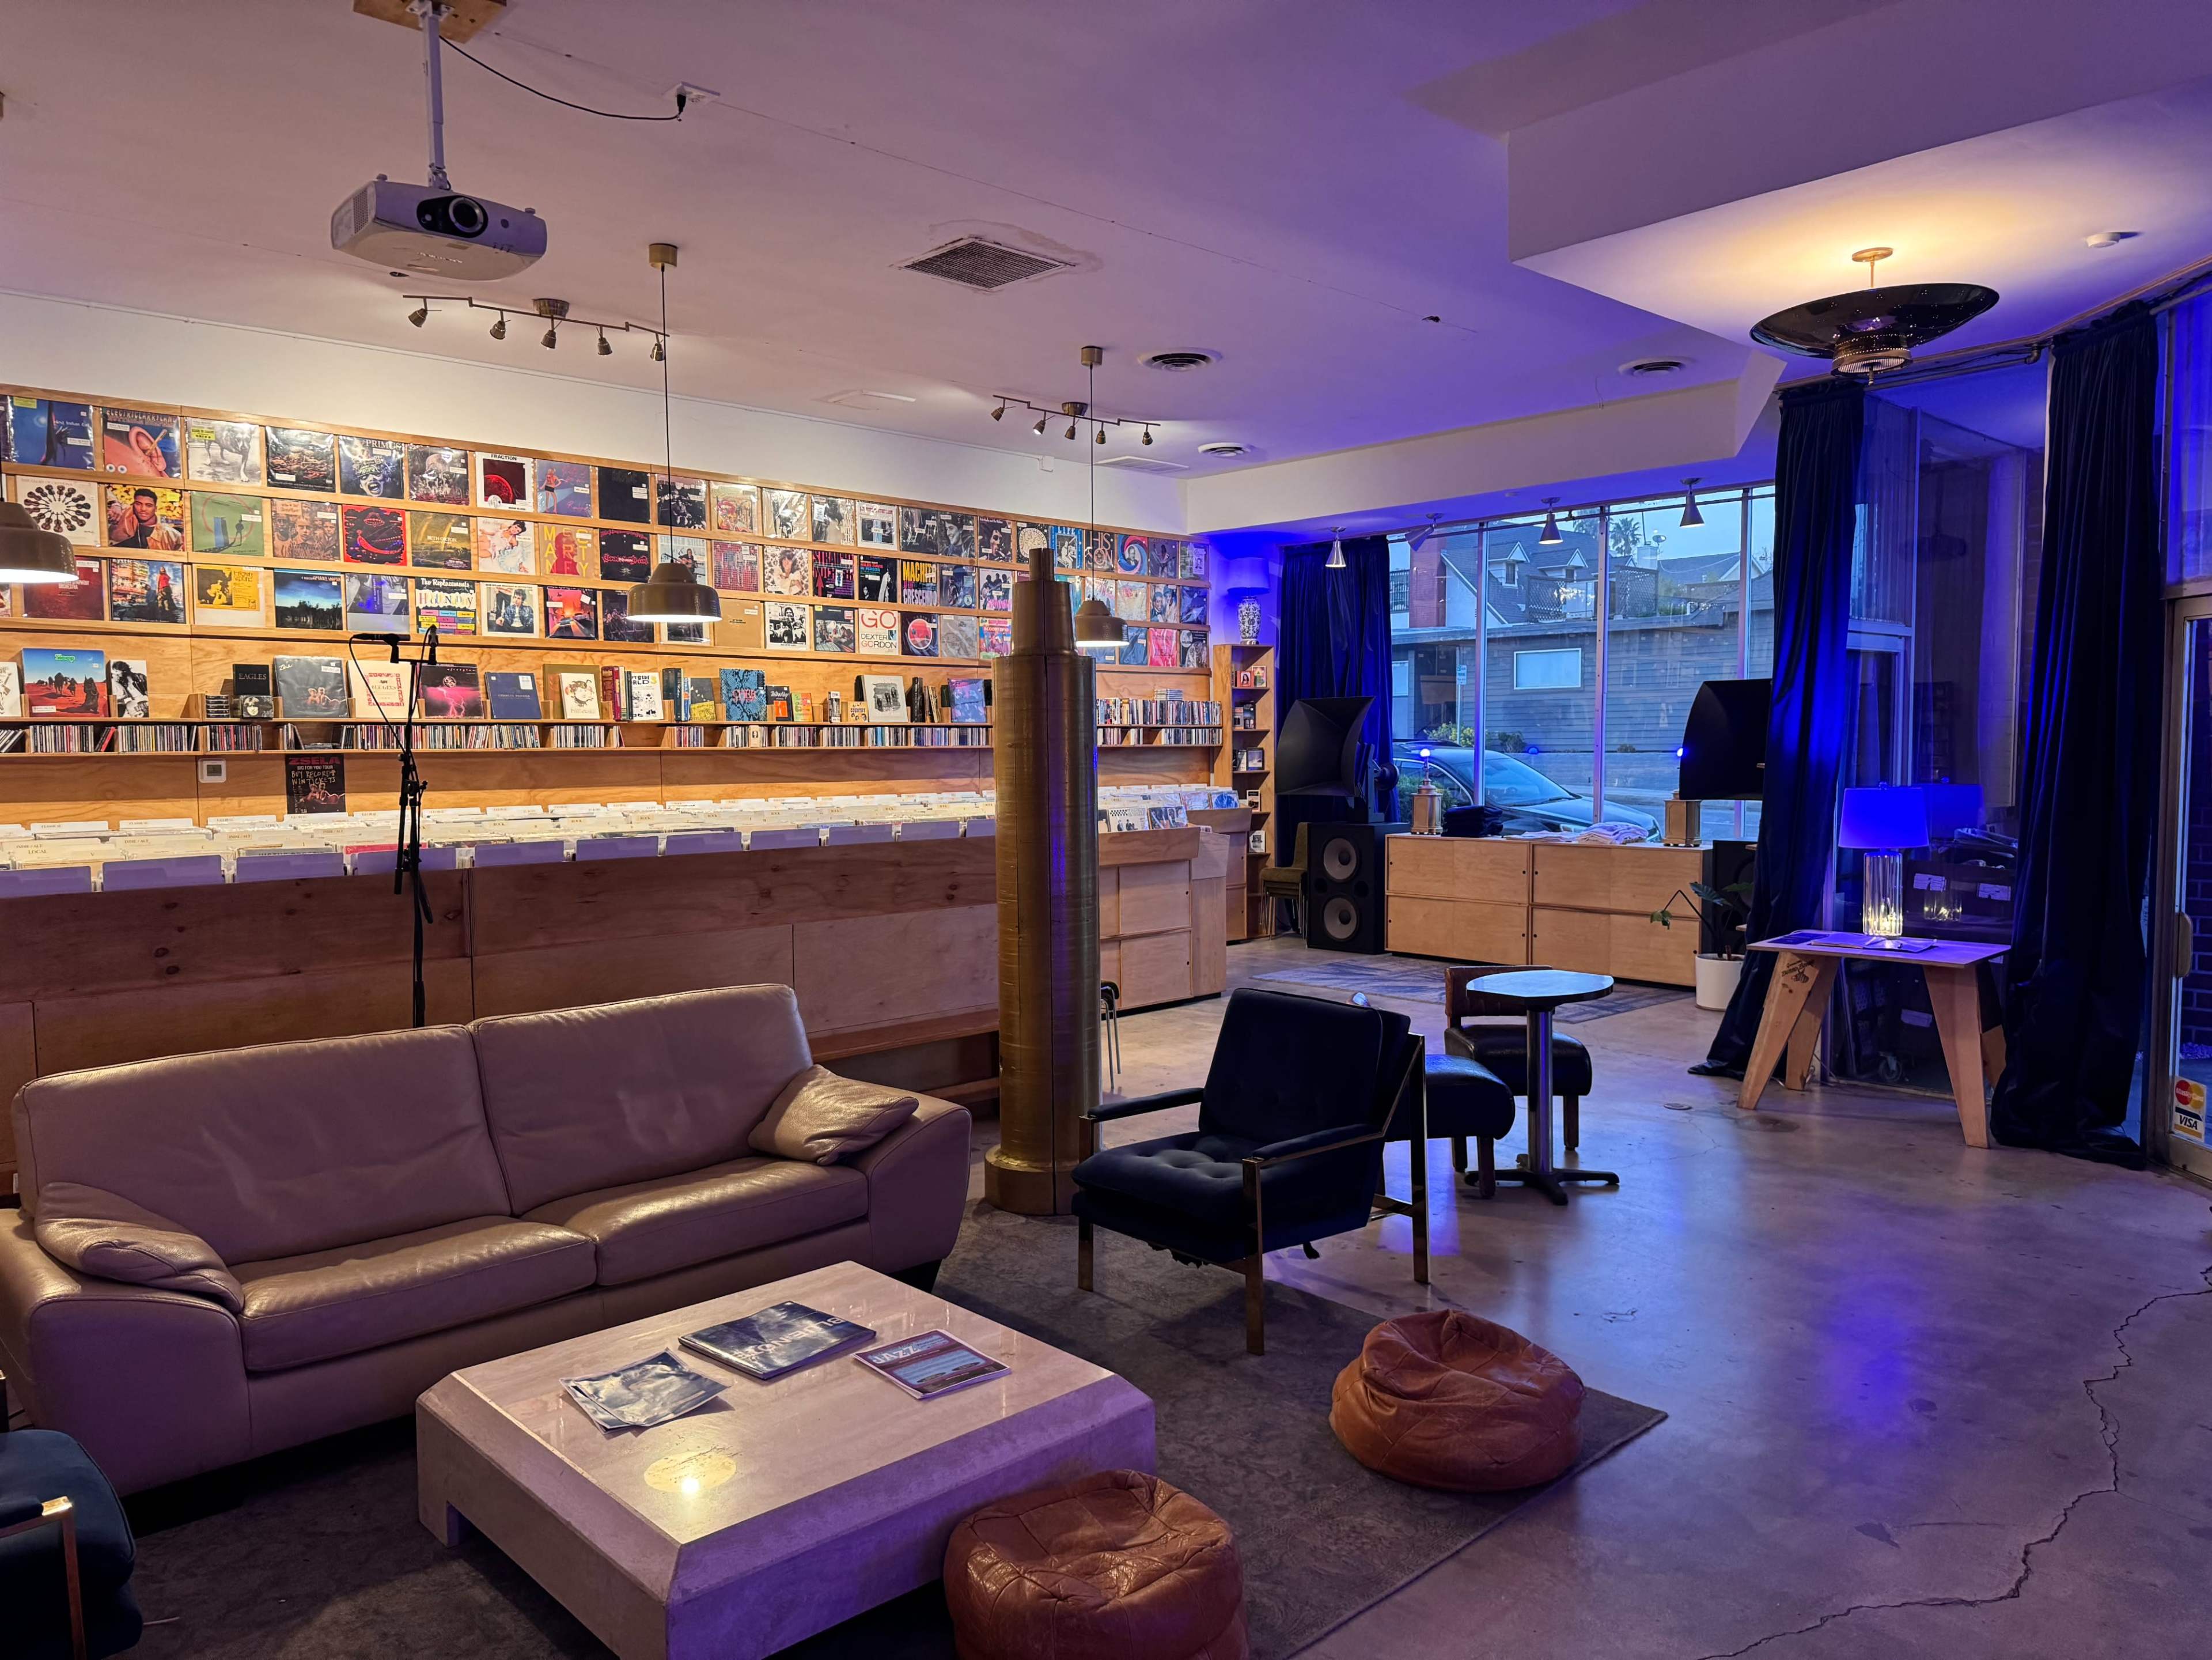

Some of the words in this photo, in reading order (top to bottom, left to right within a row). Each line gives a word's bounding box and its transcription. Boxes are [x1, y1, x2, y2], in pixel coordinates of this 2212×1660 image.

[365, 439, 402, 451] PRIMUS
[1058, 526, 1075, 535] LIFE
[1090, 531, 1111, 550] HIS
[1086, 547, 1113, 565] SON
[903, 561, 937, 583] MACHITO
[432, 579, 469, 588] Replacements
[903, 588, 937, 606] CRESCENDO
[861, 611, 896, 629] GO
[861, 640, 897, 649] GORDON
[289, 757, 341, 765] ZSELA
[2179, 1114, 2198, 1130] VISA
[872, 1344, 921, 1364] JAZZ
